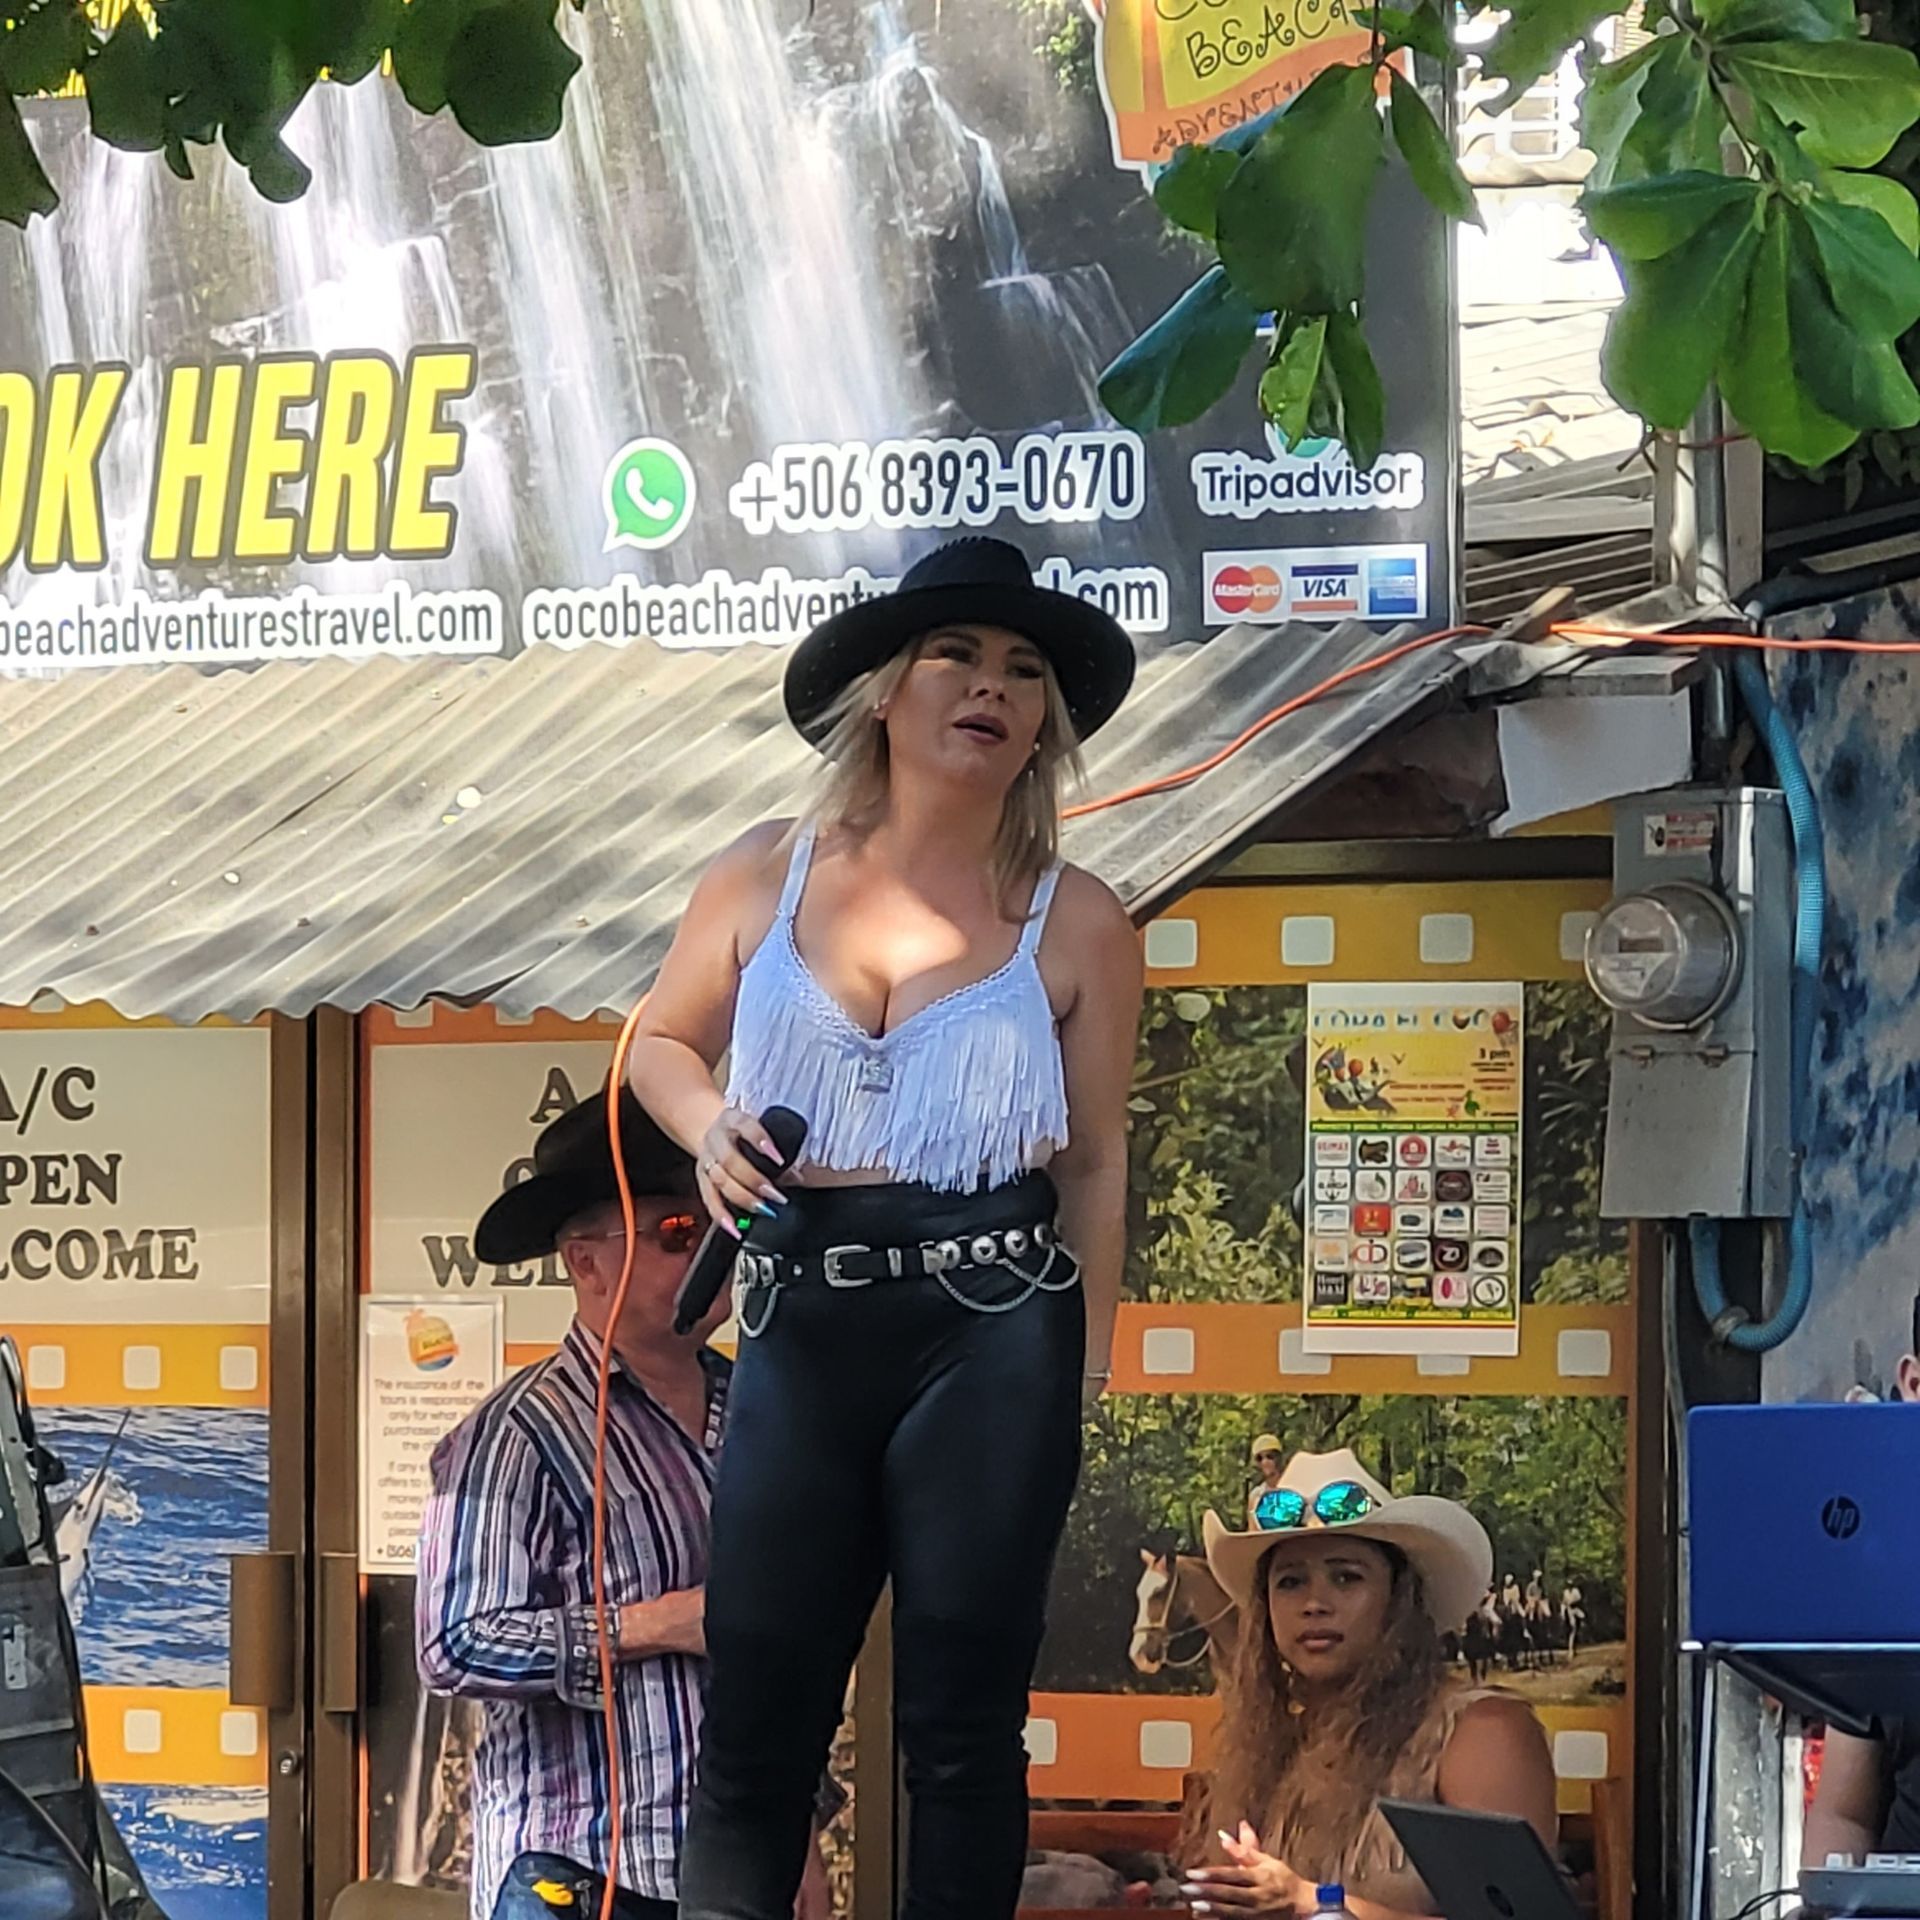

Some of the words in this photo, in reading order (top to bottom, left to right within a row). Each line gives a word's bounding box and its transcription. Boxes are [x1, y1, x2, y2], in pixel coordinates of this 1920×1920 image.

[146, 348, 475, 565] HERE
[740, 452, 863, 522] +506
[881, 442, 1135, 517] 8393-0670
[1201, 462, 1412, 507] Tripadvisor
[1303, 578, 1347, 598] VISA
[0, 1153, 122, 1205] PEN
[0, 1227, 199, 1280] COME
[1824, 1496, 1859, 1540] hp
